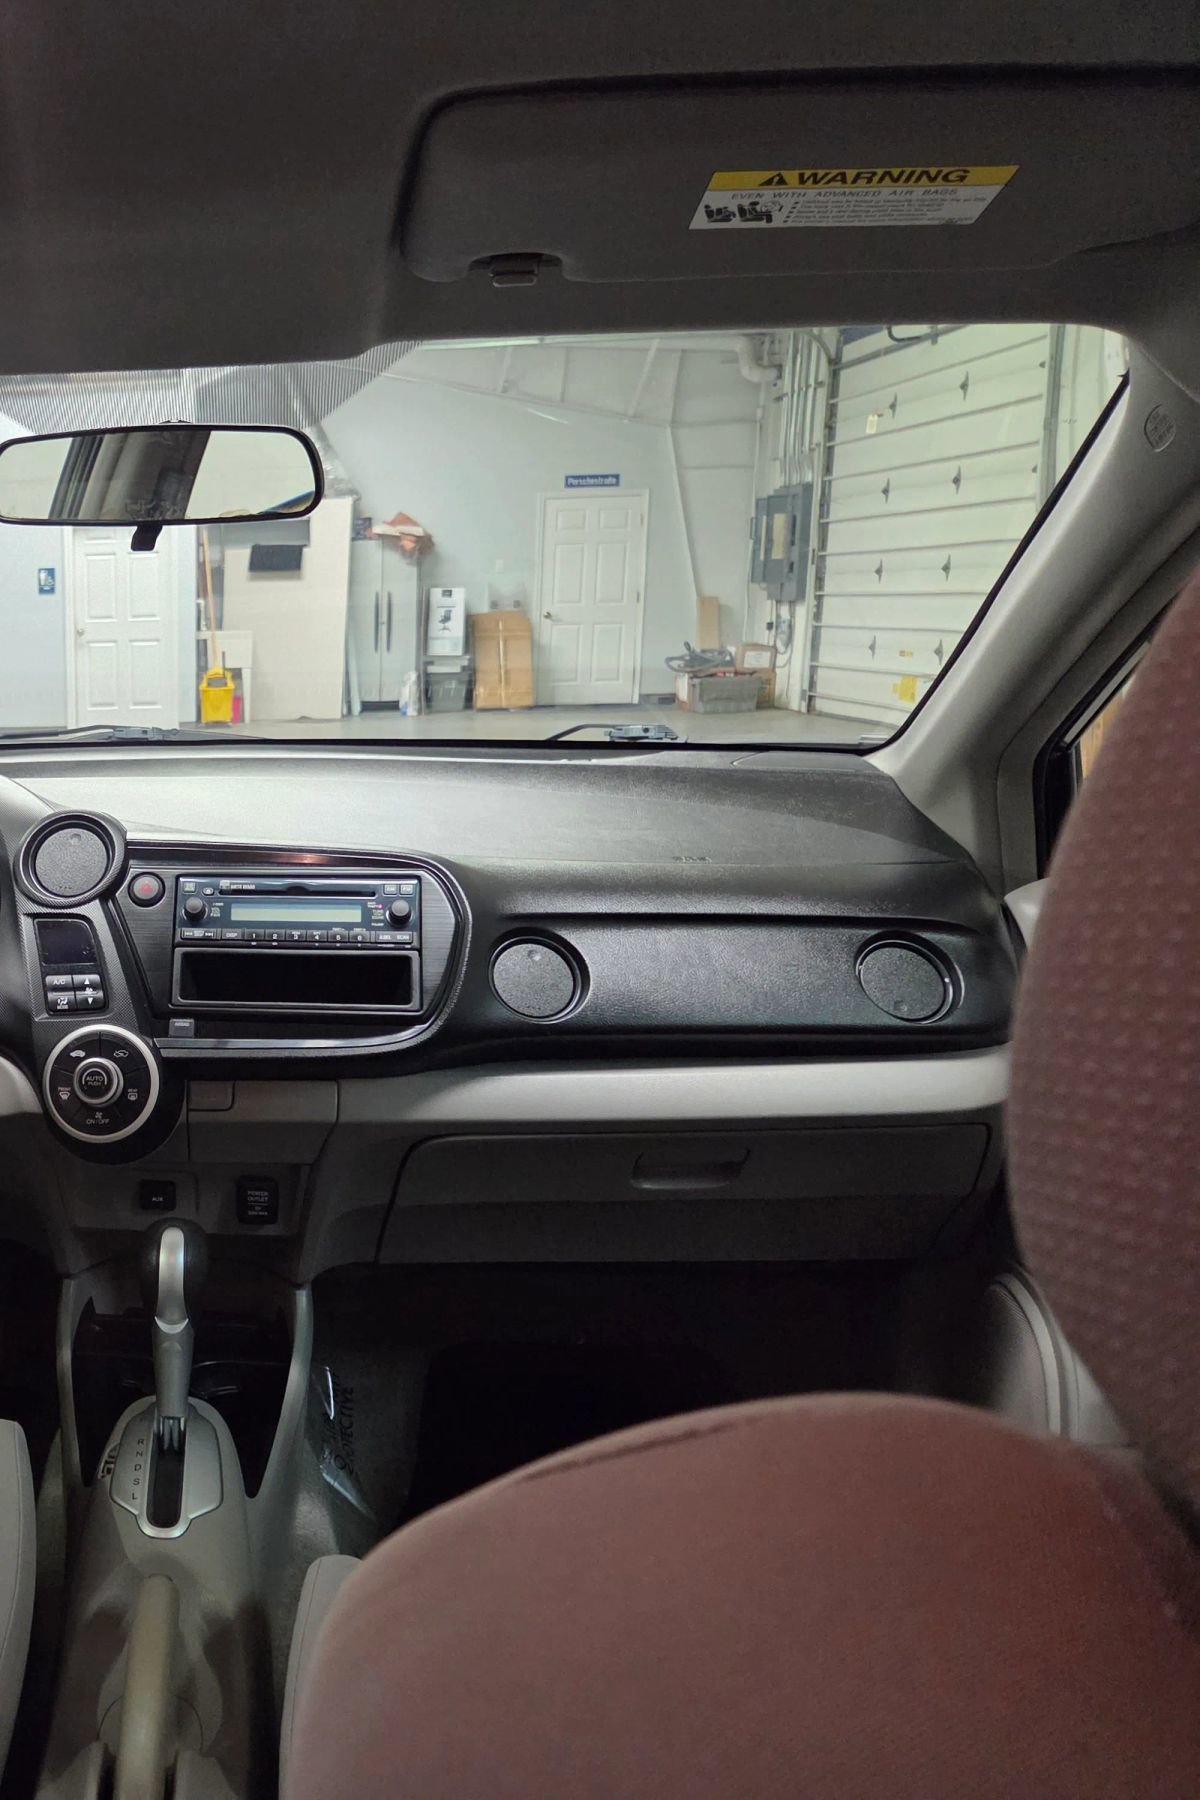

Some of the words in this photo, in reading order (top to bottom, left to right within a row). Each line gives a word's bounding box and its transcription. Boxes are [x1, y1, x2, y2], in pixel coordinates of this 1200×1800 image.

[798, 169, 971, 186] WARNING
[772, 191, 807, 199] WITH
[813, 189, 881, 198] ADVANCED
[137, 1438, 145, 1446] R
[134, 1463, 142, 1472] D
[132, 1478, 140, 1486] S
[131, 1492, 138, 1500] L
